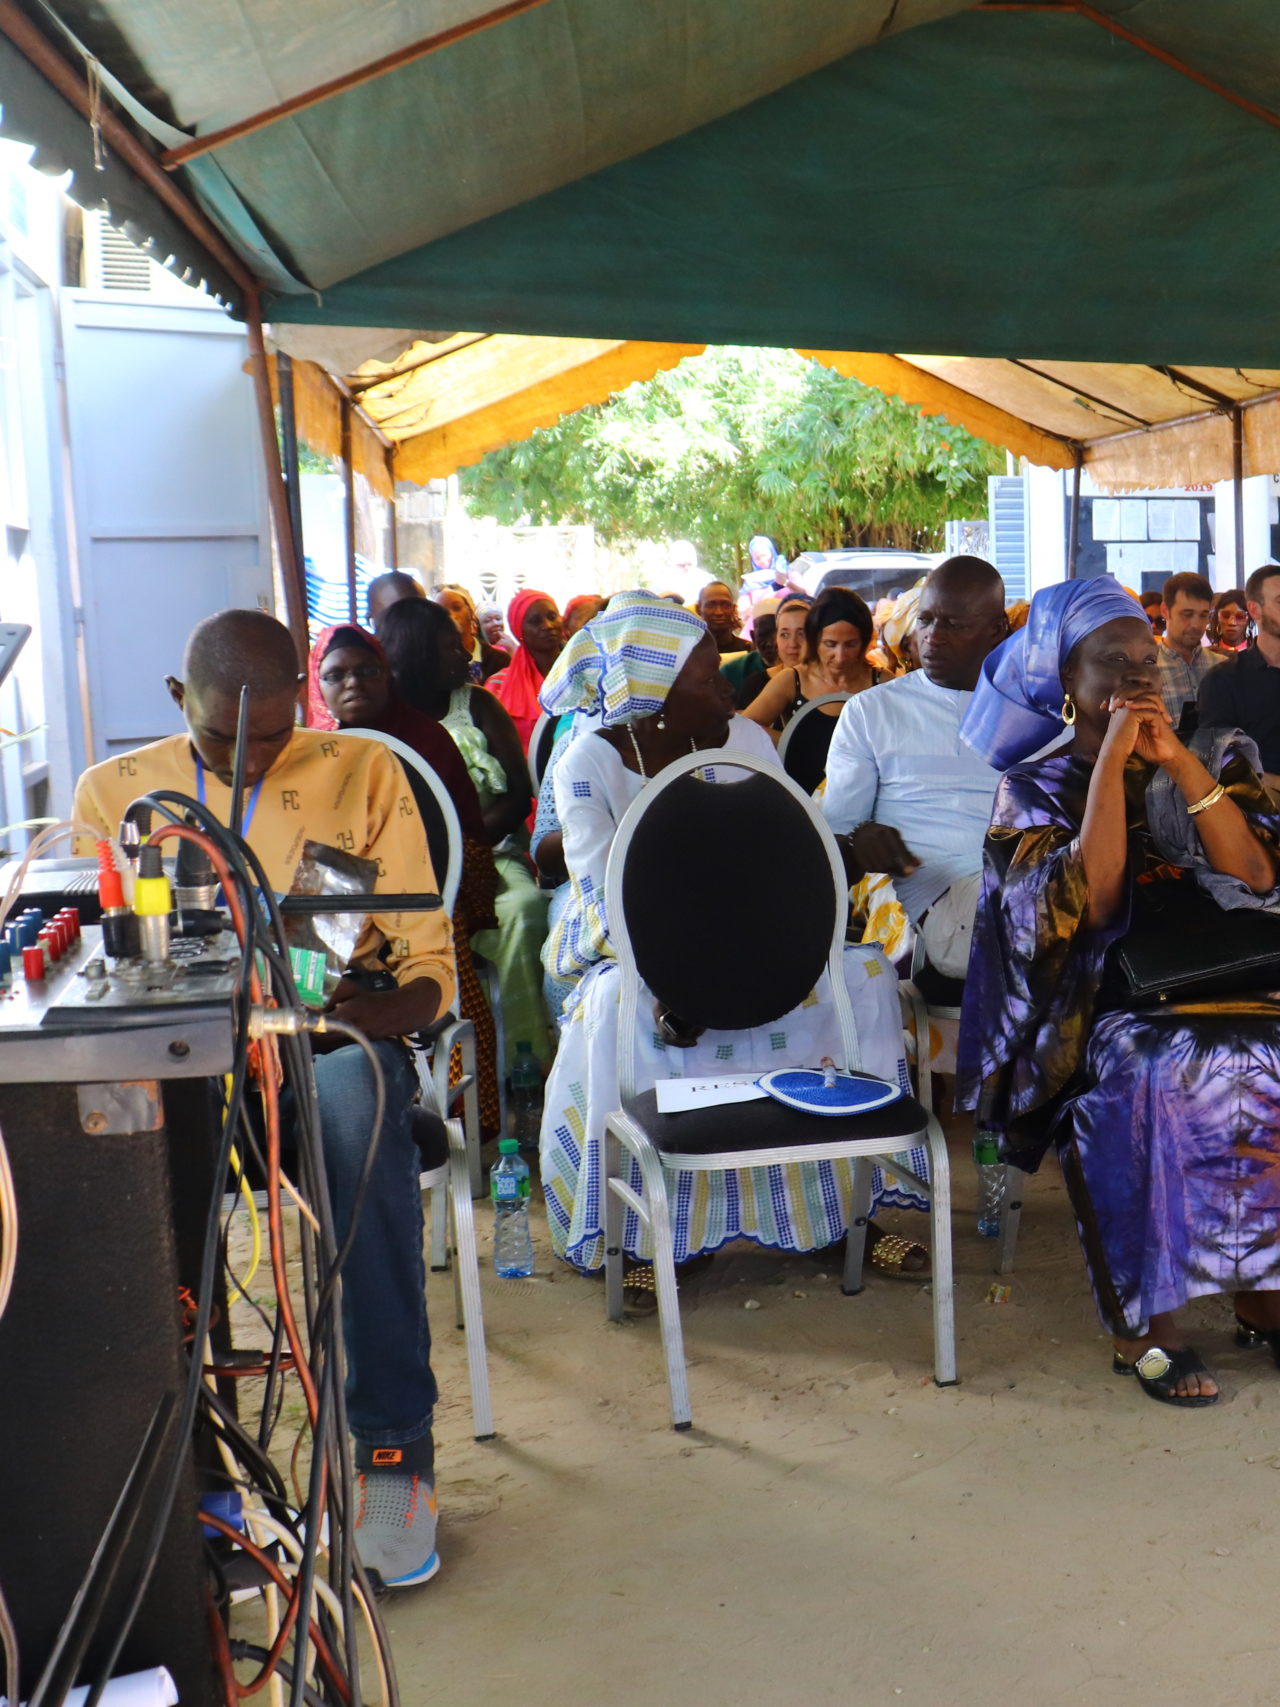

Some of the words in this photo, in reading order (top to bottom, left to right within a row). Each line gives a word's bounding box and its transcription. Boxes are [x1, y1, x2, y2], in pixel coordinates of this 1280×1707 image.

[1184, 483, 1213, 492] 2019
[117, 757, 137, 777] FC
[281, 790, 300, 810] FC
[374, 1450, 398, 1461] NIKE
